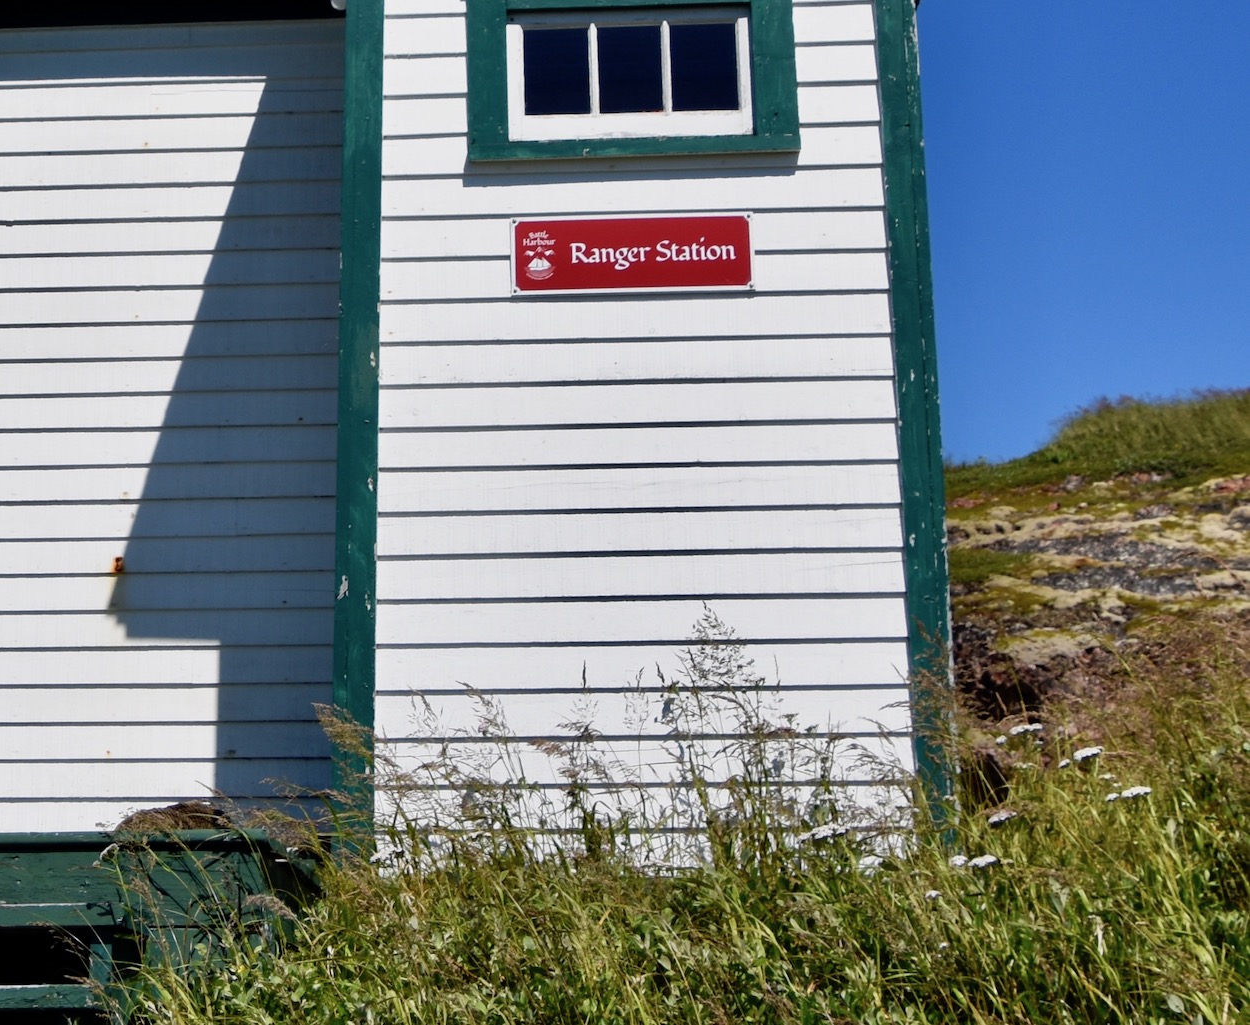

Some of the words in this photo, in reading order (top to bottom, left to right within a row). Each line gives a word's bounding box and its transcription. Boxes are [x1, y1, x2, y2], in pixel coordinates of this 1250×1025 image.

[528, 230, 550, 240] Battle
[522, 238, 556, 247] Harbour
[569, 241, 651, 271] Ranger
[655, 236, 737, 263] Station
